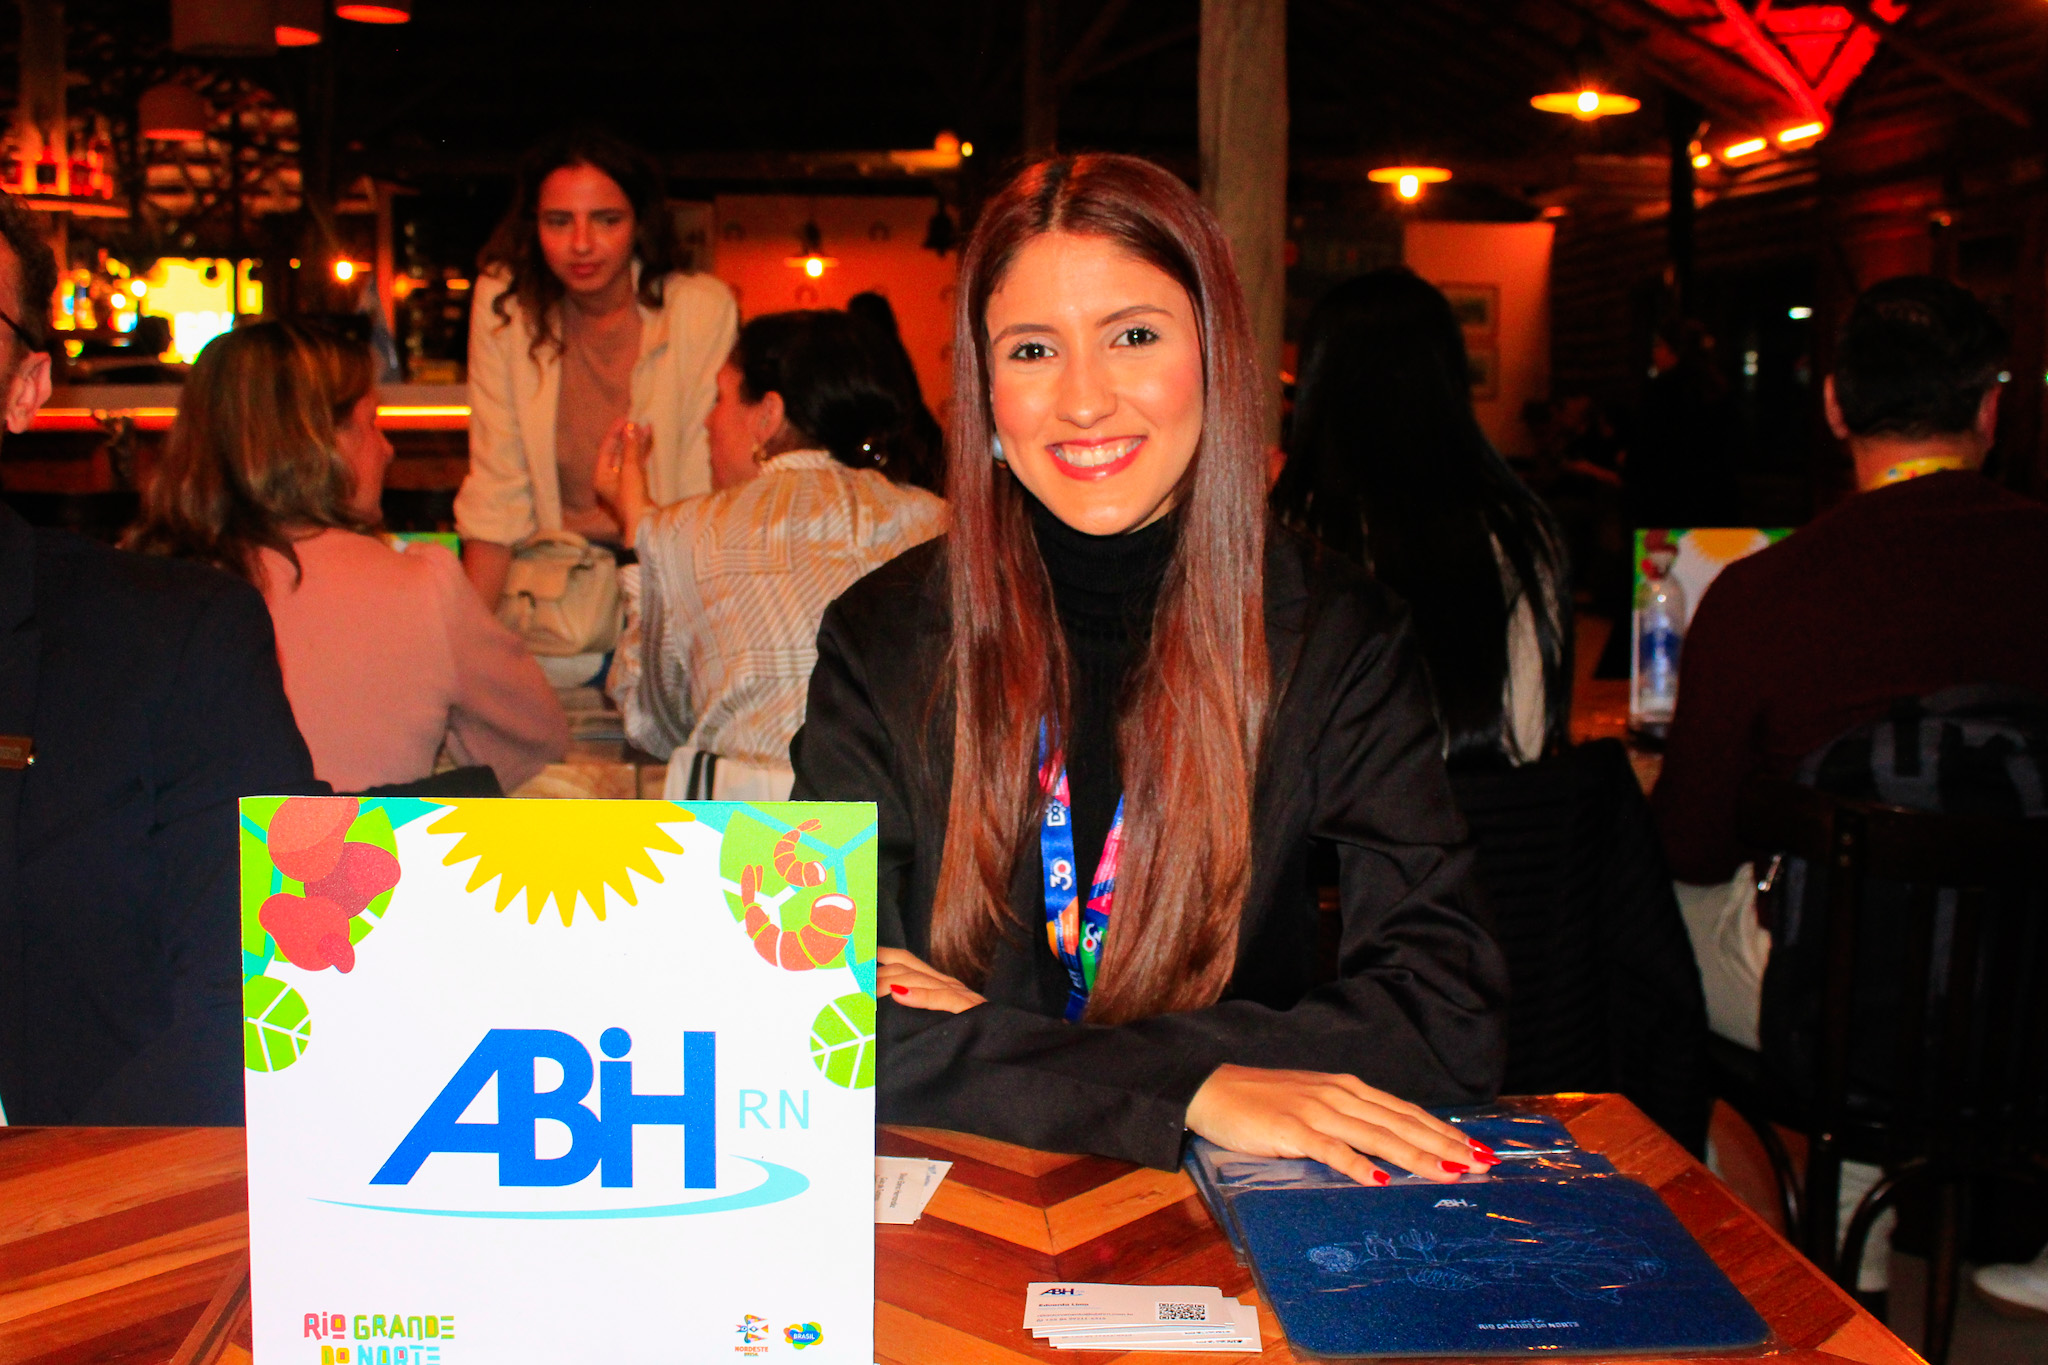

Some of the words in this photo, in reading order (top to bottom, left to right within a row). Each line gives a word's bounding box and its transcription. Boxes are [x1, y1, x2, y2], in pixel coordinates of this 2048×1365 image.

[739, 1089, 810, 1130] RN
[353, 1314, 455, 1341] GRANDE
[357, 1344, 440, 1365] NORTE
